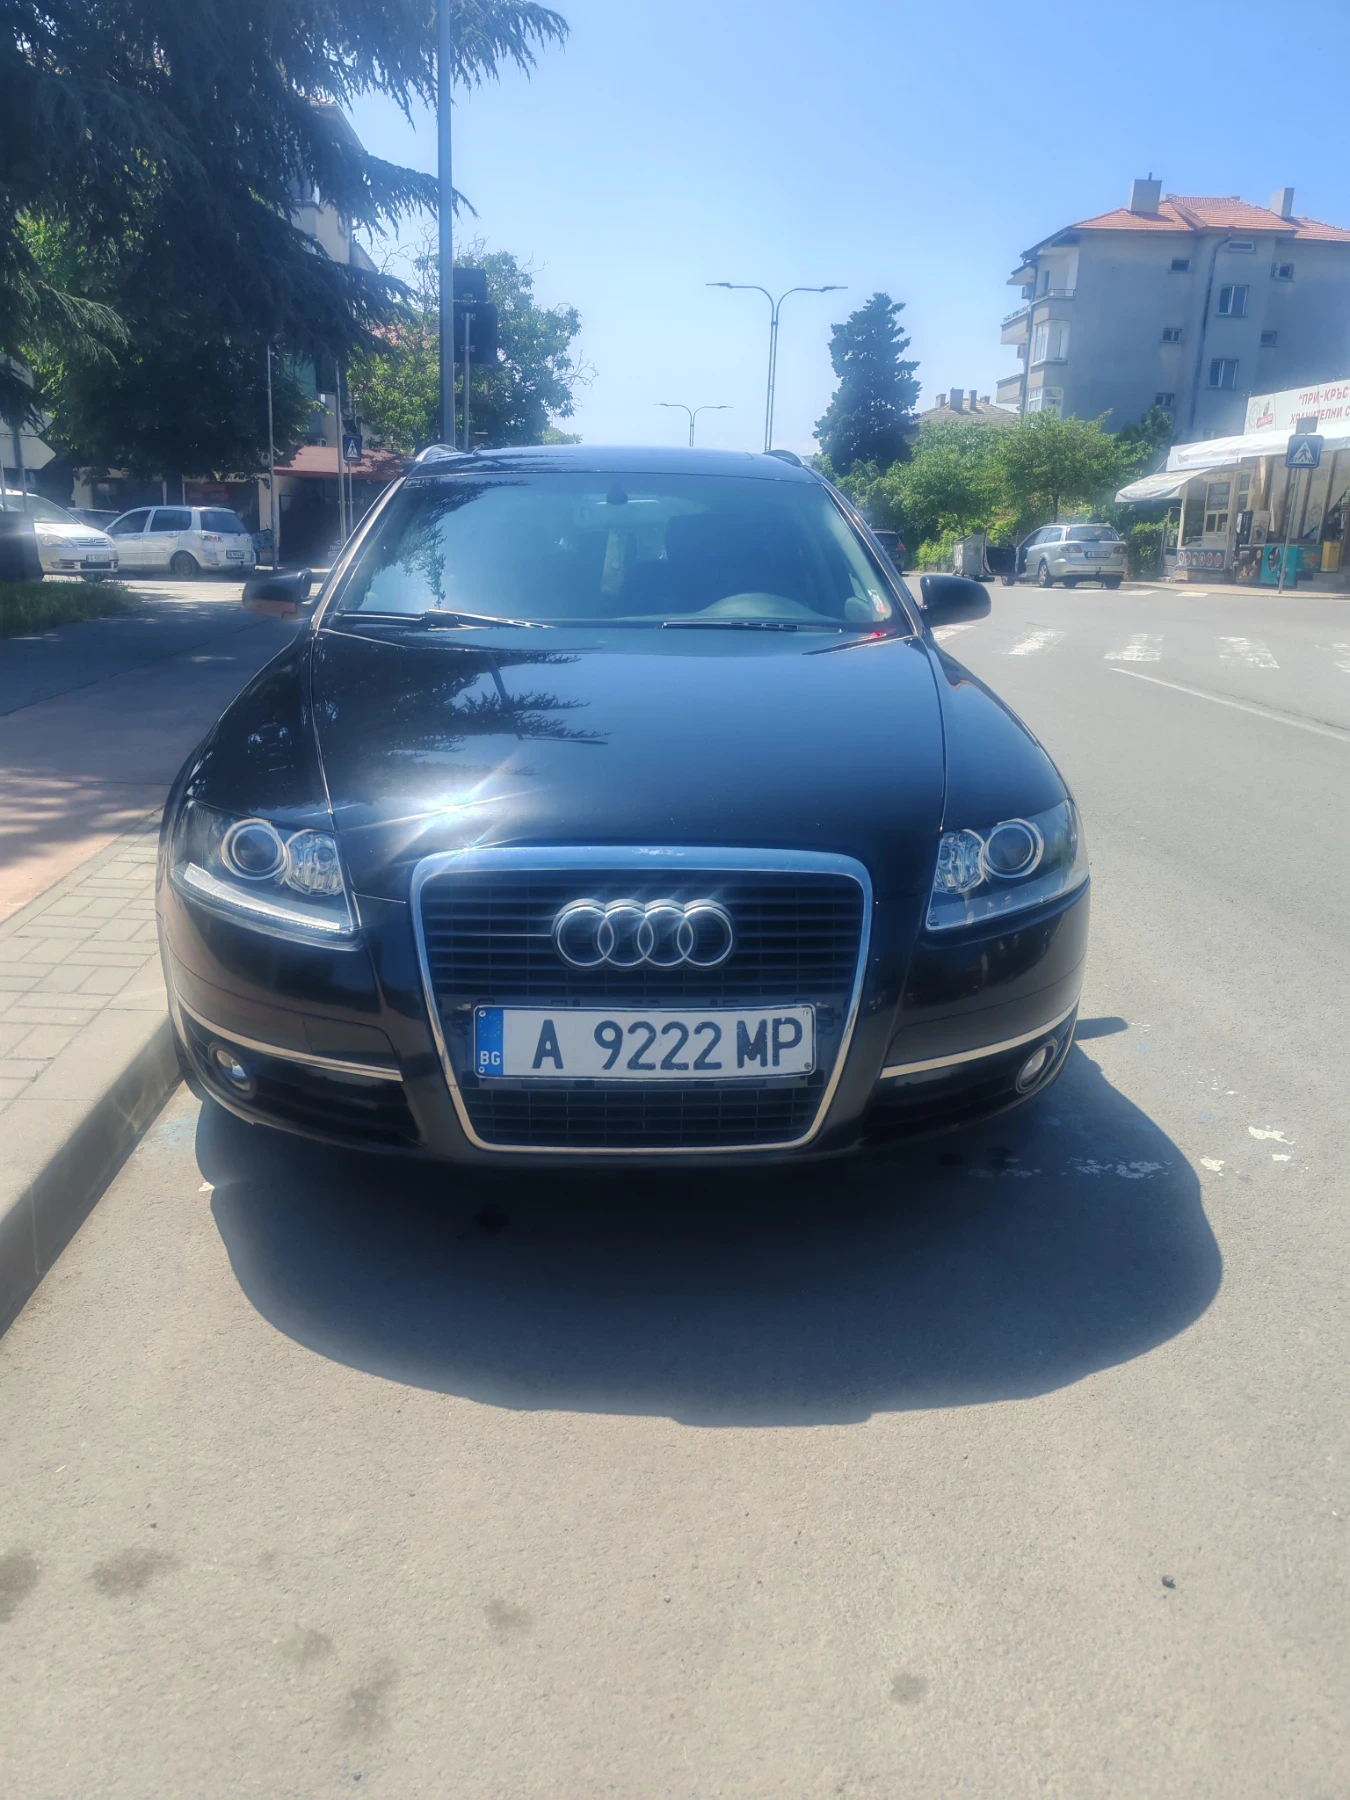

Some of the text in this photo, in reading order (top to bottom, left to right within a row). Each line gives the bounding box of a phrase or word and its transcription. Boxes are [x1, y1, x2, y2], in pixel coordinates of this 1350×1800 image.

[1299, 386, 1350, 406] "ПРИ-КРЪС
[532, 1016, 803, 1071] A 9222 MP
[480, 1051, 500, 1066] BG
